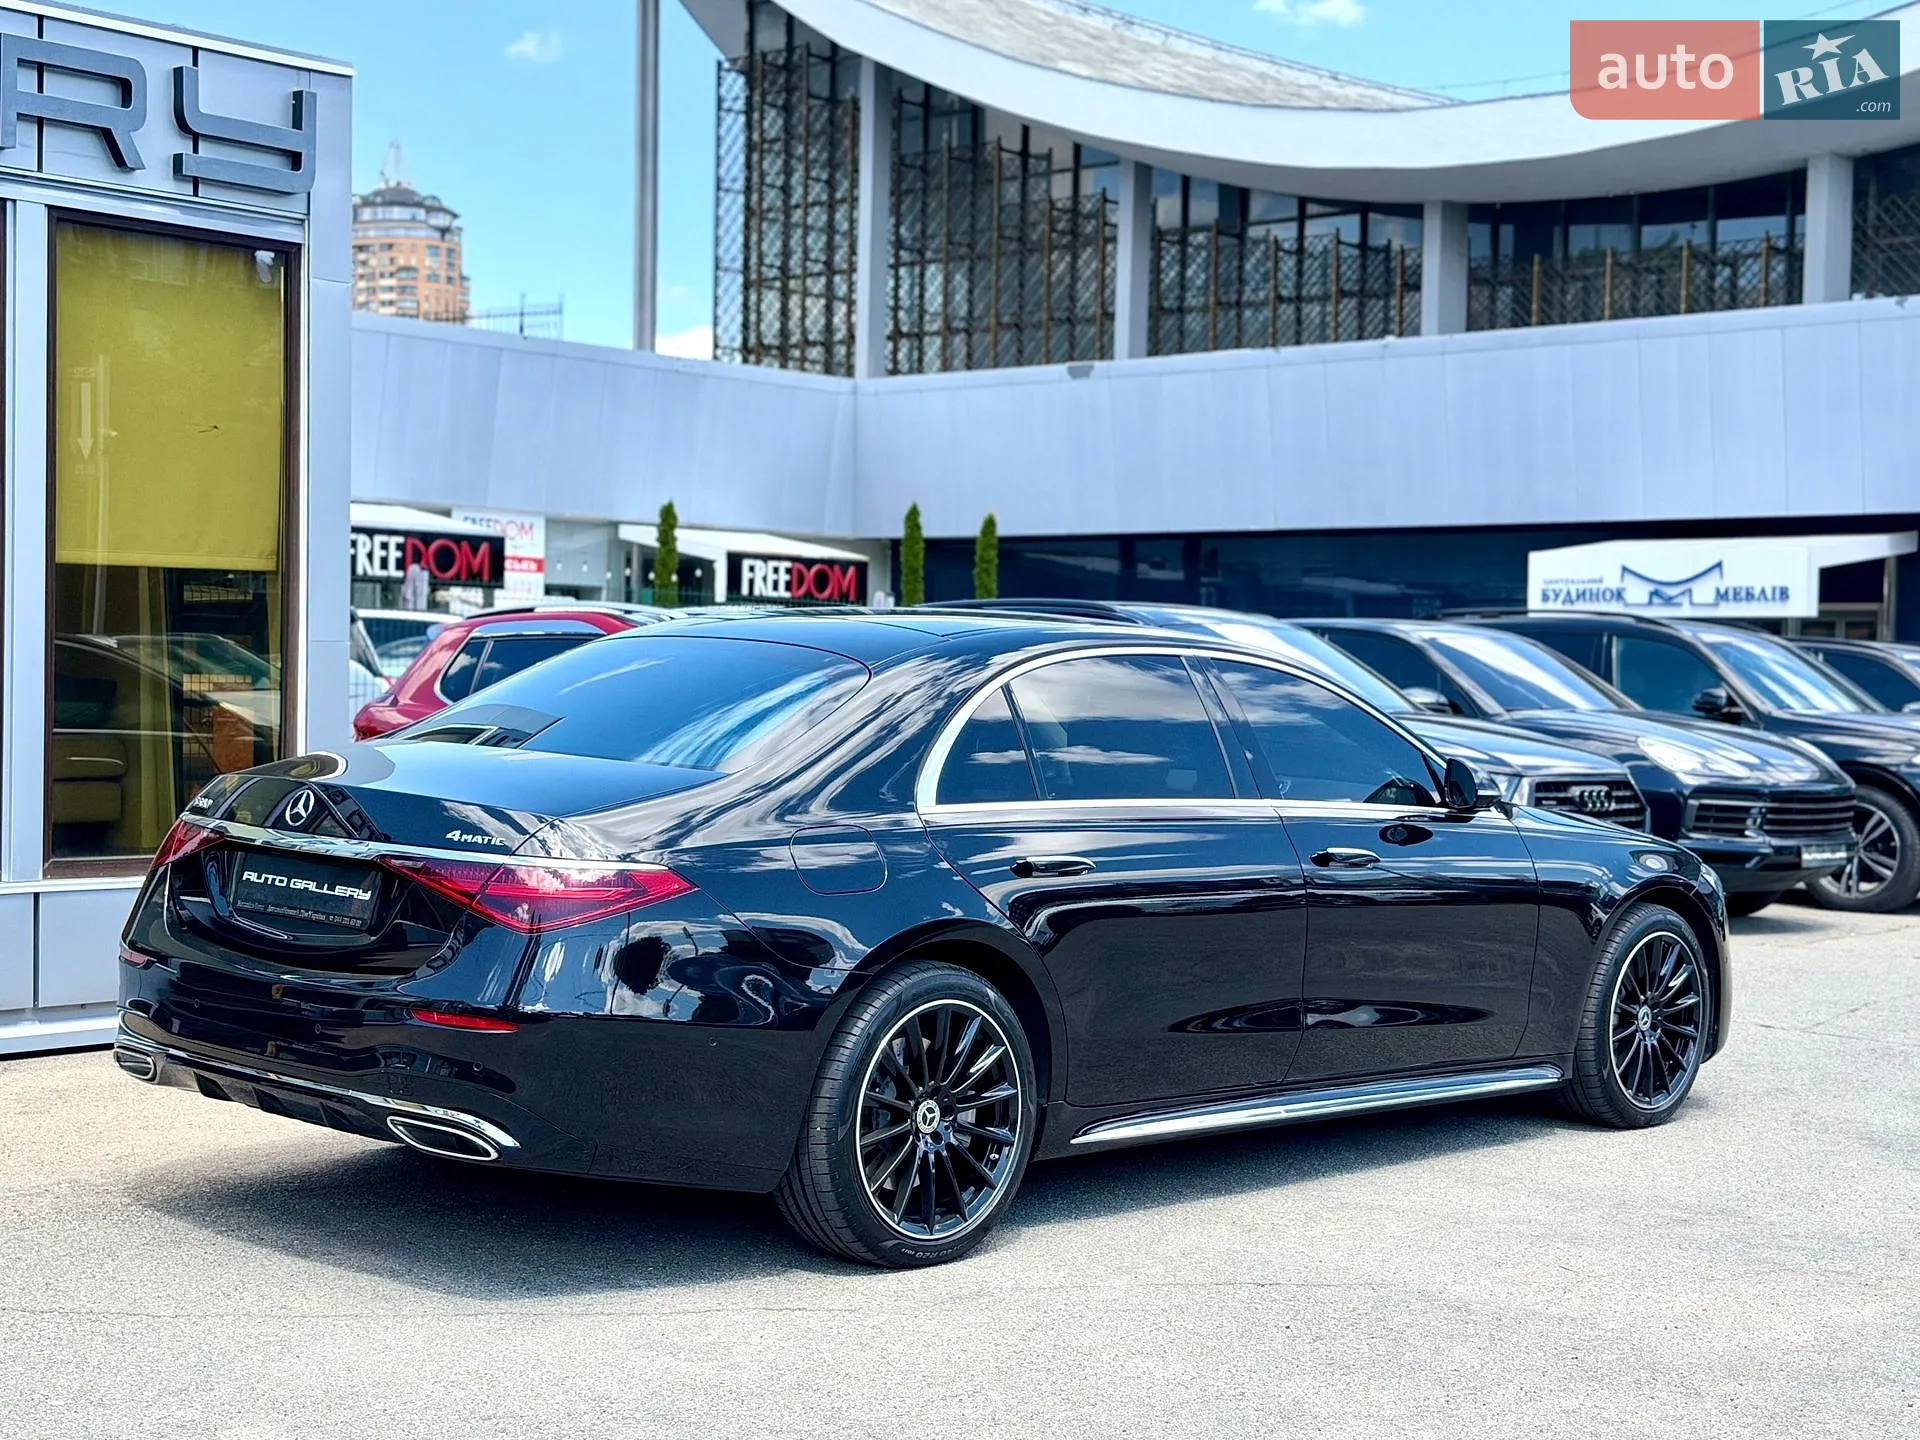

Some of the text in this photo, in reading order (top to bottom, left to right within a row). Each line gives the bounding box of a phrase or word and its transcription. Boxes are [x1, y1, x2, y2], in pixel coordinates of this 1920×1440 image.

[1, 33, 317, 194] RY
[741, 558, 857, 602] FREEDOM
[1541, 585, 1790, 606] БУДИНОК МЕБЛІВ
[446, 830, 506, 846] 4MATIC
[242, 871, 372, 901] AUTO GALLERY
